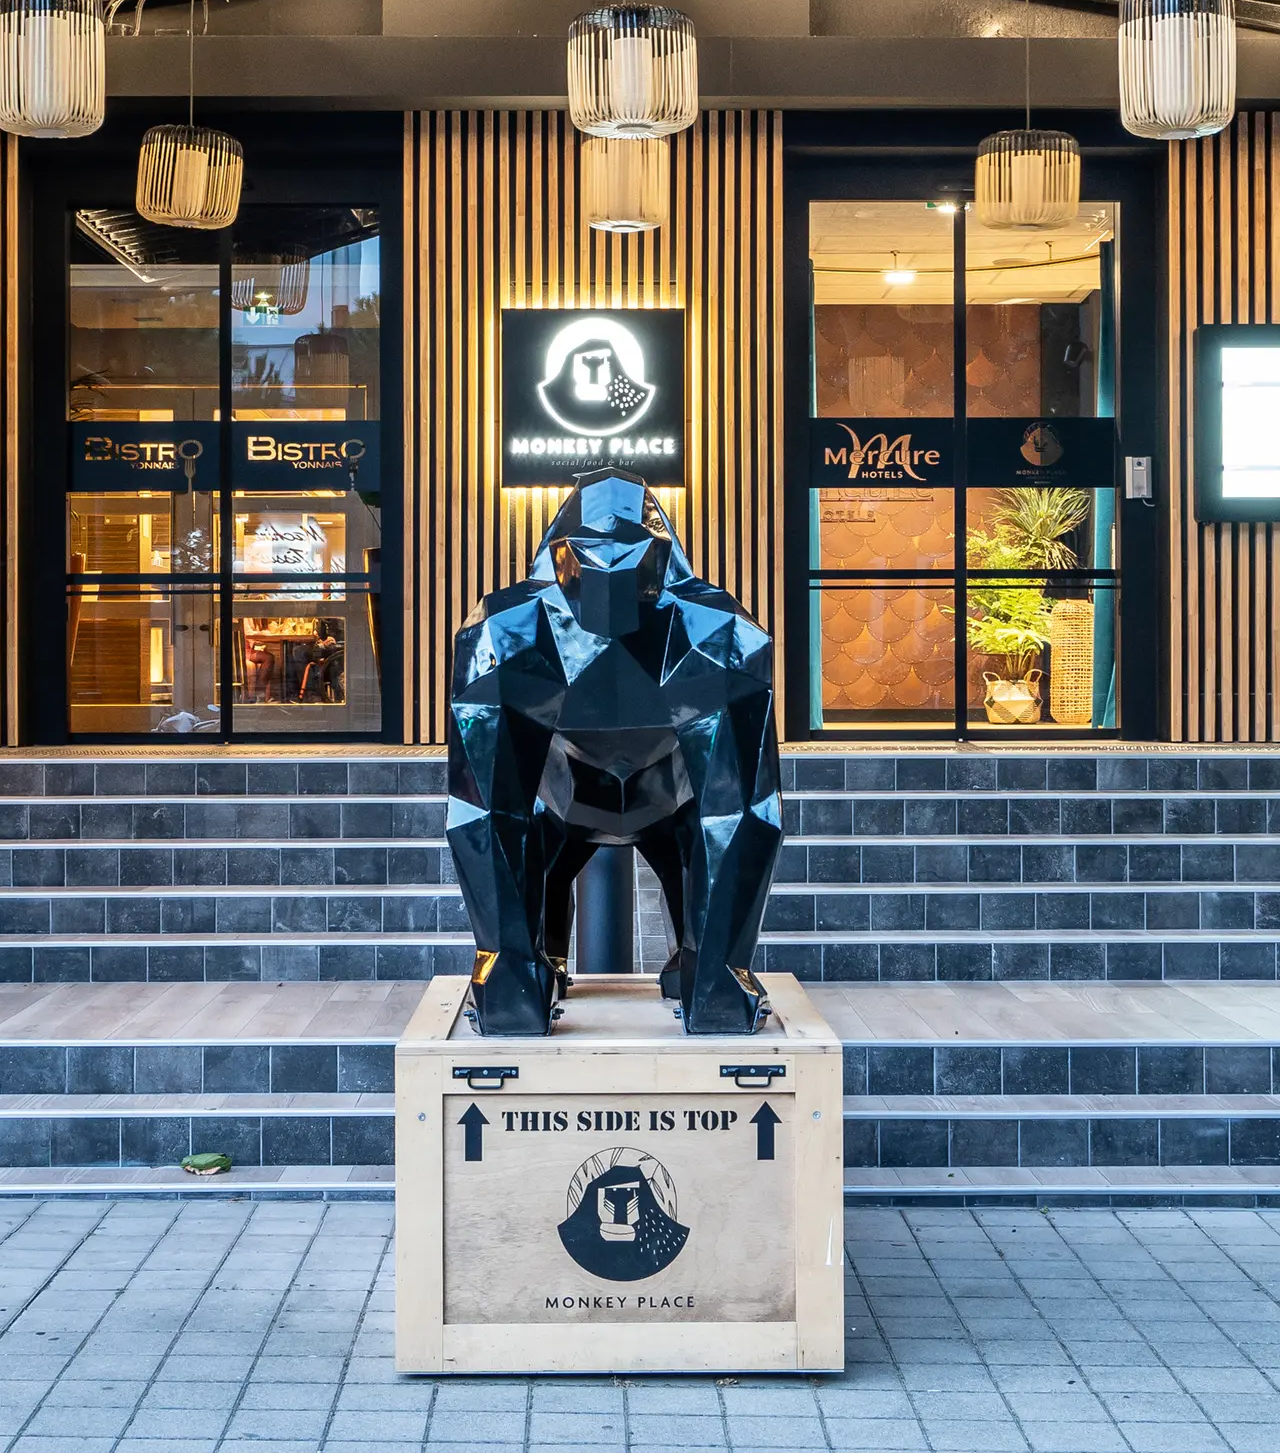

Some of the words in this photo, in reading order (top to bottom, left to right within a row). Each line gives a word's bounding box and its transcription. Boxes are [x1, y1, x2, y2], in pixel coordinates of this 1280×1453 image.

[246, 436, 366, 461] BISTRO
[510, 437, 603, 455] MONKEY
[609, 437, 676, 455] PLACE
[551, 458, 579, 466] social
[582, 458, 603, 468] food
[619, 458, 635, 466] bar
[824, 447, 941, 466] Mercure
[292, 461, 343, 469] YONNAIS
[861, 471, 904, 479] HOTELS
[501, 1110, 569, 1132] THIS
[576, 1110, 641, 1132] SIDE
[648, 1110, 676, 1132] IS
[683, 1110, 739, 1131] TOP
[545, 1296, 627, 1309] MONKEY
[637, 1296, 695, 1309] PLACE
